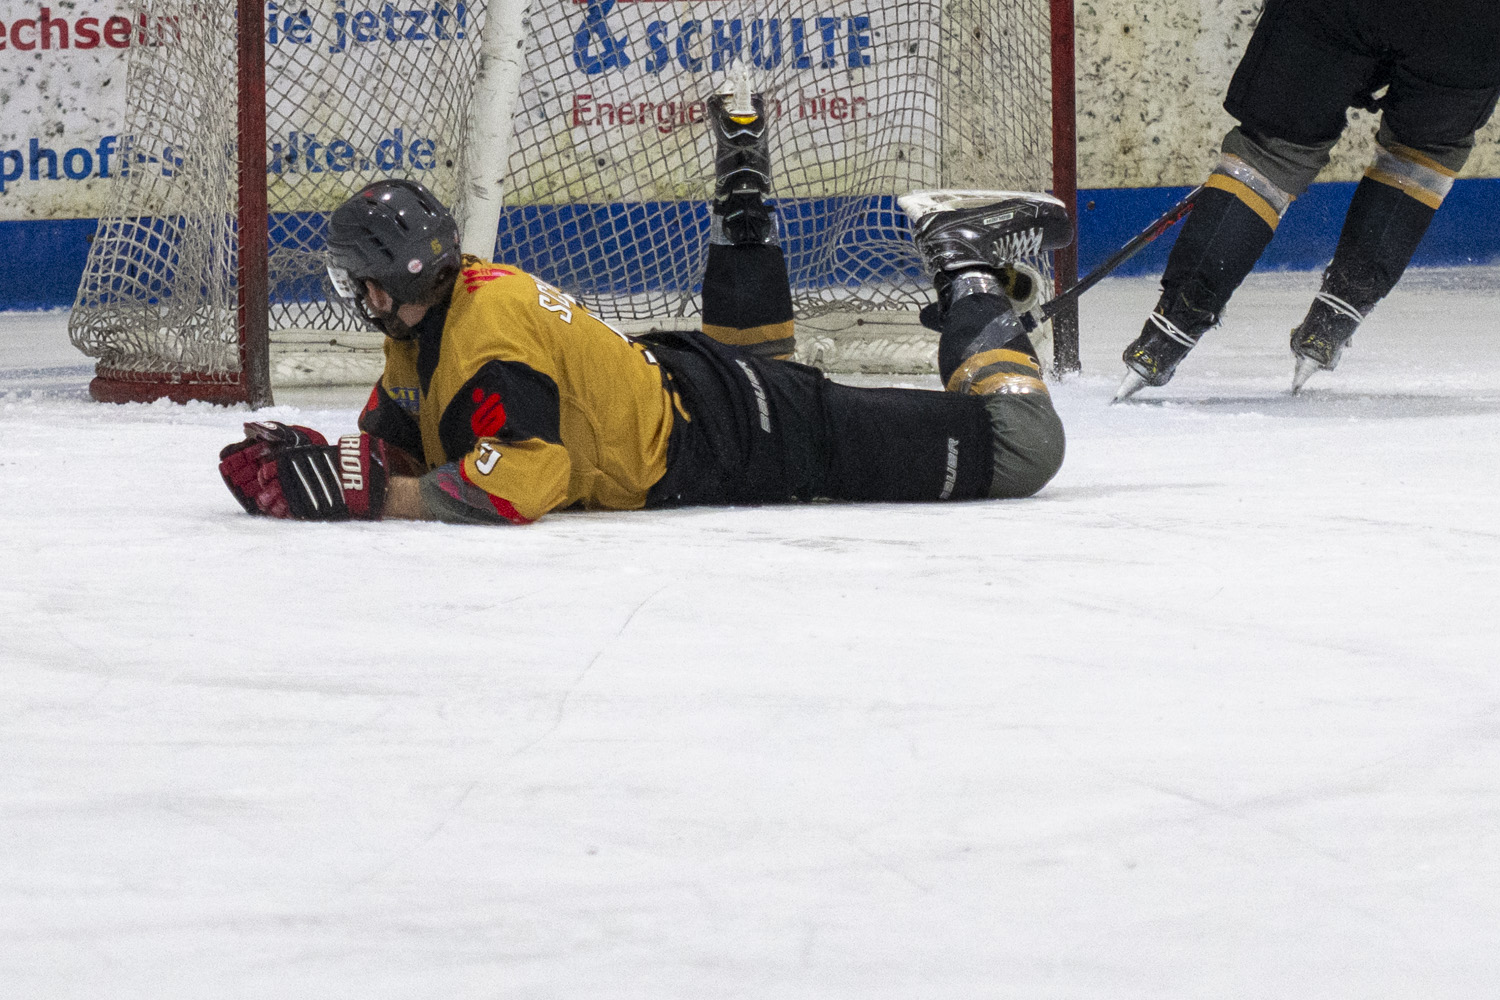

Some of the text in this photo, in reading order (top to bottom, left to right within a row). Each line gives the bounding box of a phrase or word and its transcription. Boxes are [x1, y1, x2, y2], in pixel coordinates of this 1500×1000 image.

[328, 0, 467, 54] jetzt!
[645, 16, 871, 74] SCHULTE
[572, 94, 706, 133] Energie
[799, 88, 872, 121] hier.
